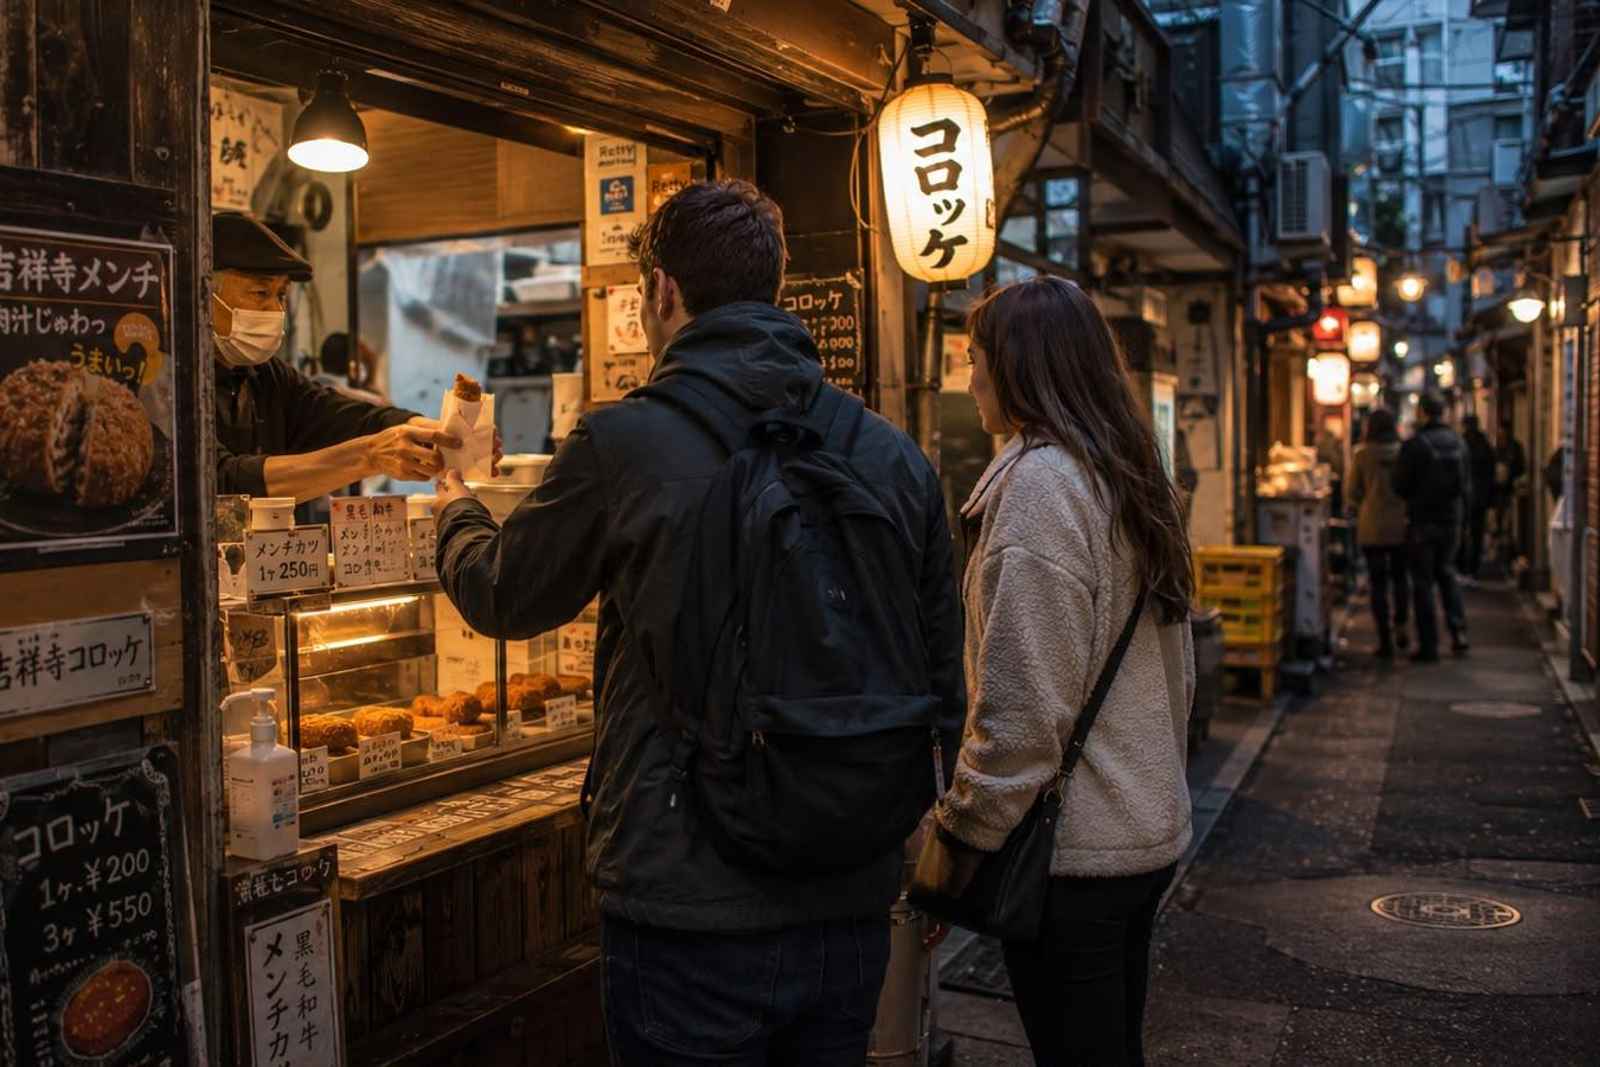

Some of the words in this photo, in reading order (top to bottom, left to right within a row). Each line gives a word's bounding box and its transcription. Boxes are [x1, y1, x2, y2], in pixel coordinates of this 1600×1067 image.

[910, 118, 968, 269] コロッケ
[783, 289, 844, 312] コロッケ
[256, 539, 319, 558] メンチカツ
[12, 796, 131, 865] コロッケ
[263, 932, 290, 1067] メンチカ
[295, 929, 318, 1052] 黒毛和牛
